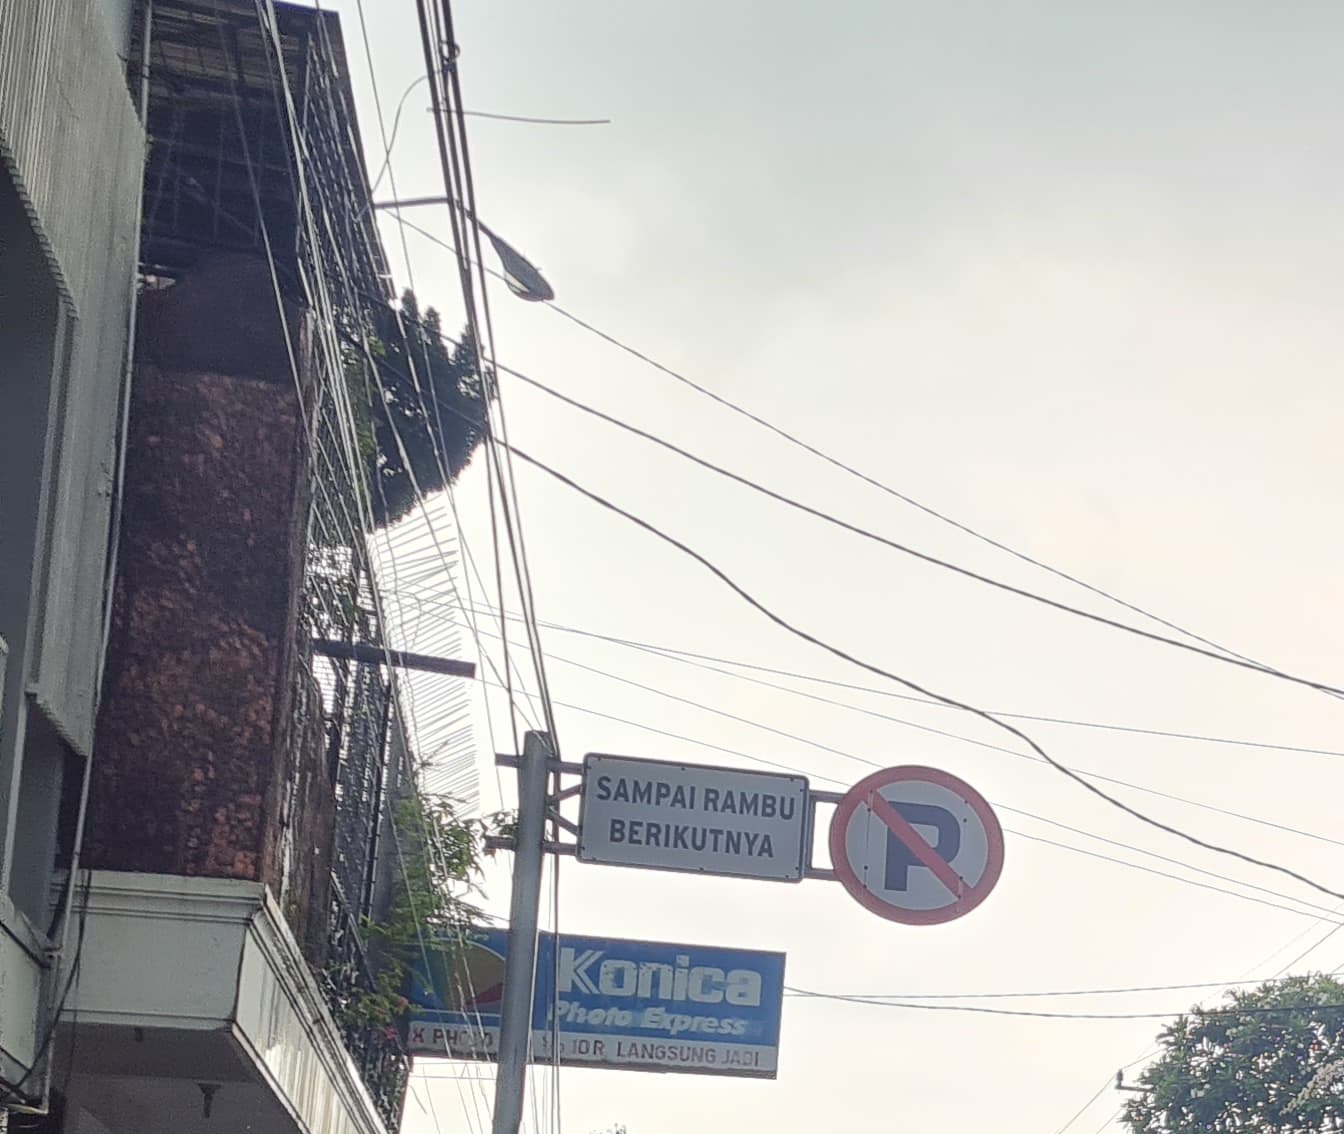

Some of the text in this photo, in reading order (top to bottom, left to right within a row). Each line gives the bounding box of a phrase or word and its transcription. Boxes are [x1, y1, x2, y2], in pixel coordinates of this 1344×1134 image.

[597, 776, 795, 821] SAMPAI RAMBU
[609, 818, 775, 858] BERIKUTNYA
[558, 946, 762, 1007] Konica
[549, 1000, 749, 1035] Photo Express
[616, 1041, 716, 1064] LANGSUNG
[720, 1049, 760, 1068] JADI
